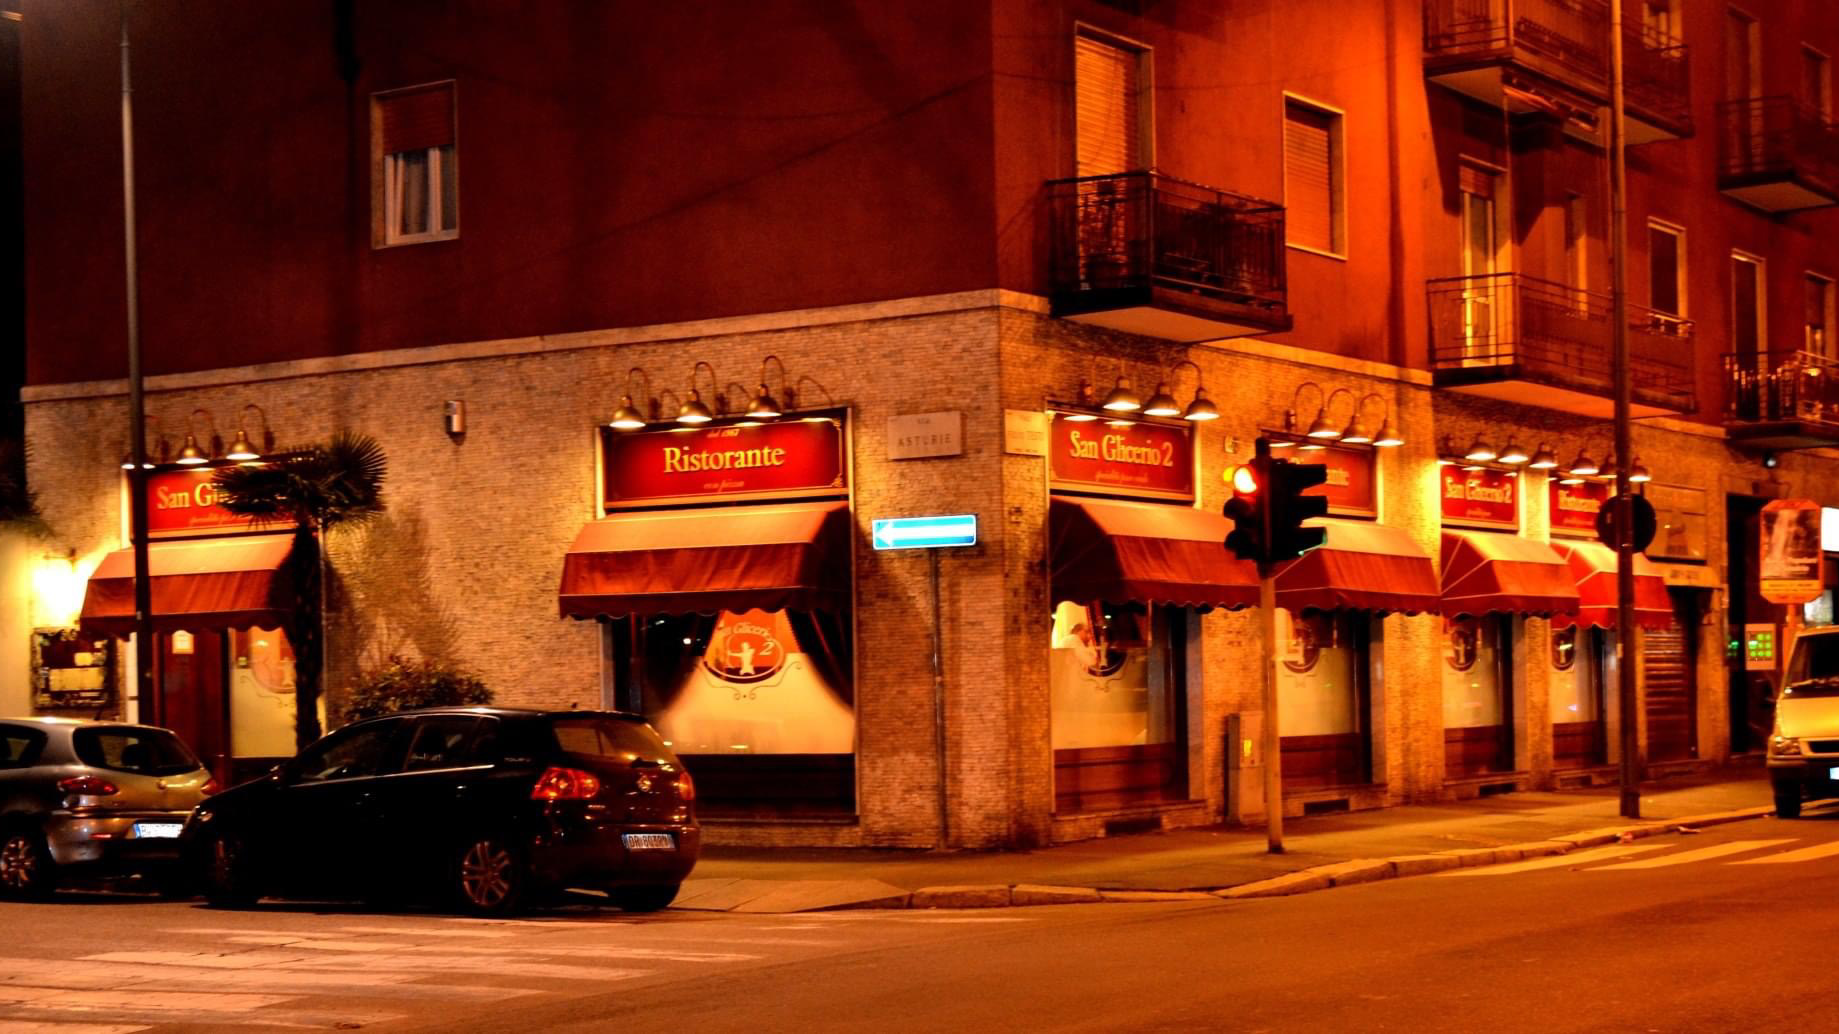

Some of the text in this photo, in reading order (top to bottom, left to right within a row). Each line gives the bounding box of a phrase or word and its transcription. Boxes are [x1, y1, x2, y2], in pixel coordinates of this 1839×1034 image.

[898, 432, 952, 448] ASTURIE
[1069, 430, 1099, 460] San
[1102, 434, 1161, 466] Glicerio
[1162, 441, 1174, 467] 2
[662, 446, 786, 473] Ristorante
[156, 486, 191, 510] San
[759, 641, 775, 656] 2
